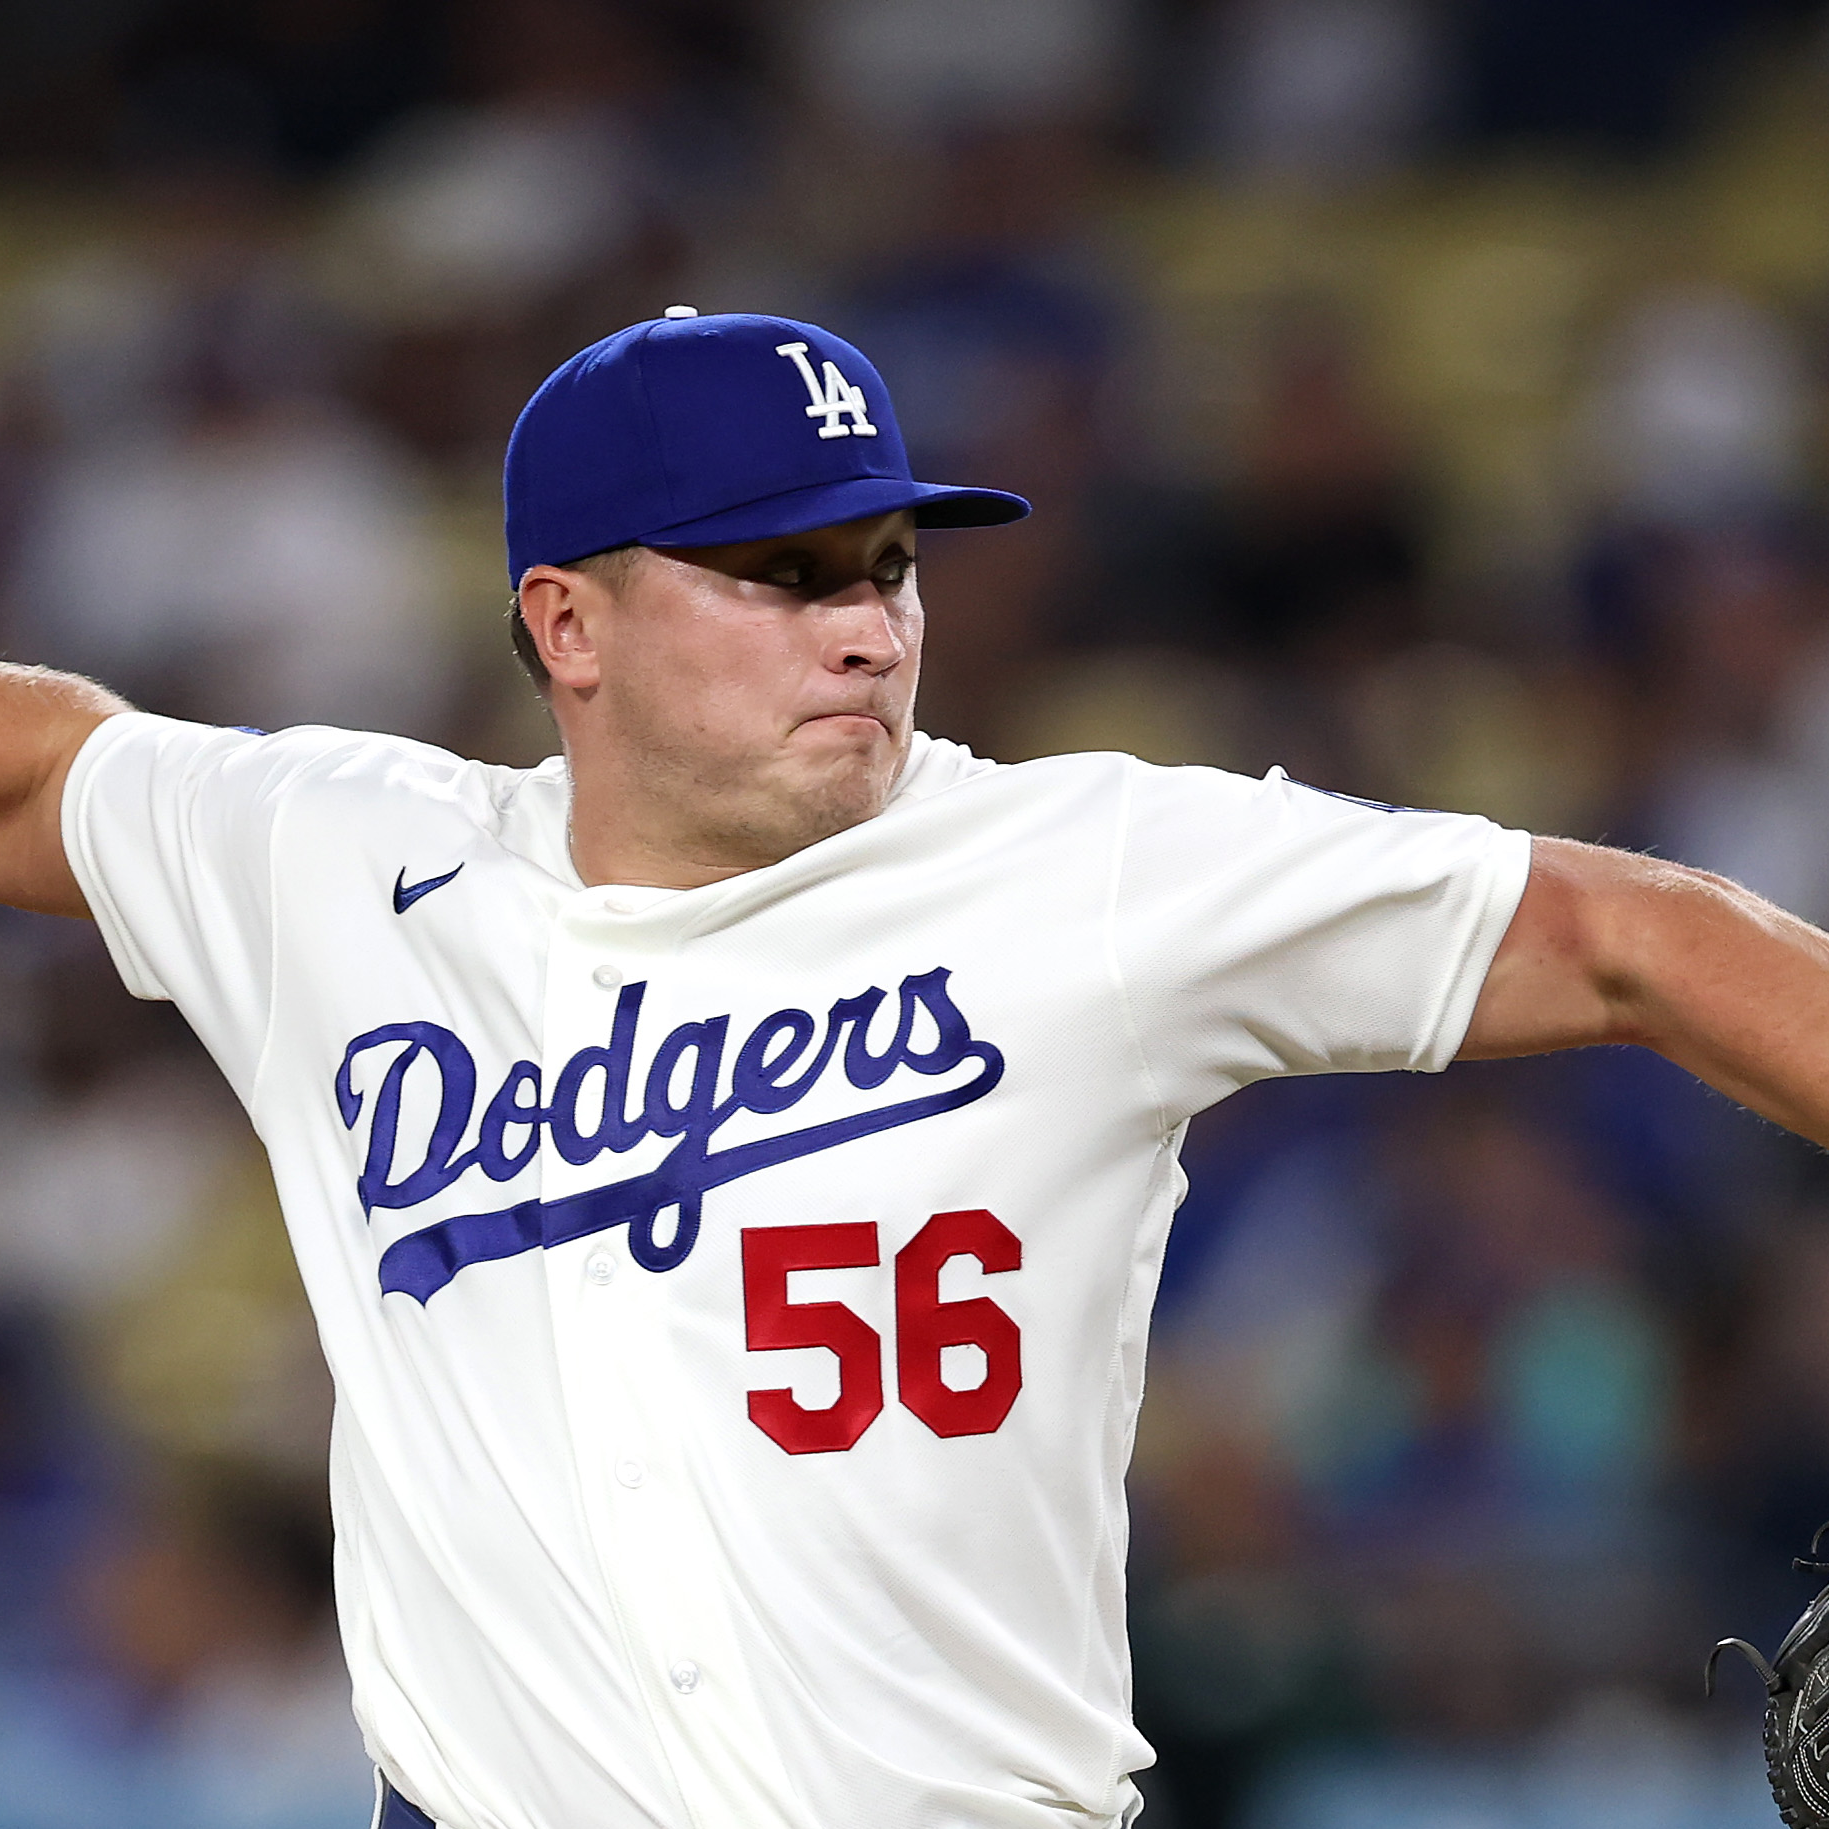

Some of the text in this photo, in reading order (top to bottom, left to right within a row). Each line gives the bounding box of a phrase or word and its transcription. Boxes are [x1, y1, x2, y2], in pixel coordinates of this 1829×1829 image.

[775, 341, 878, 440] LA
[335, 966, 1005, 1273] Dodgers
[740, 1208, 1023, 1455] 56
